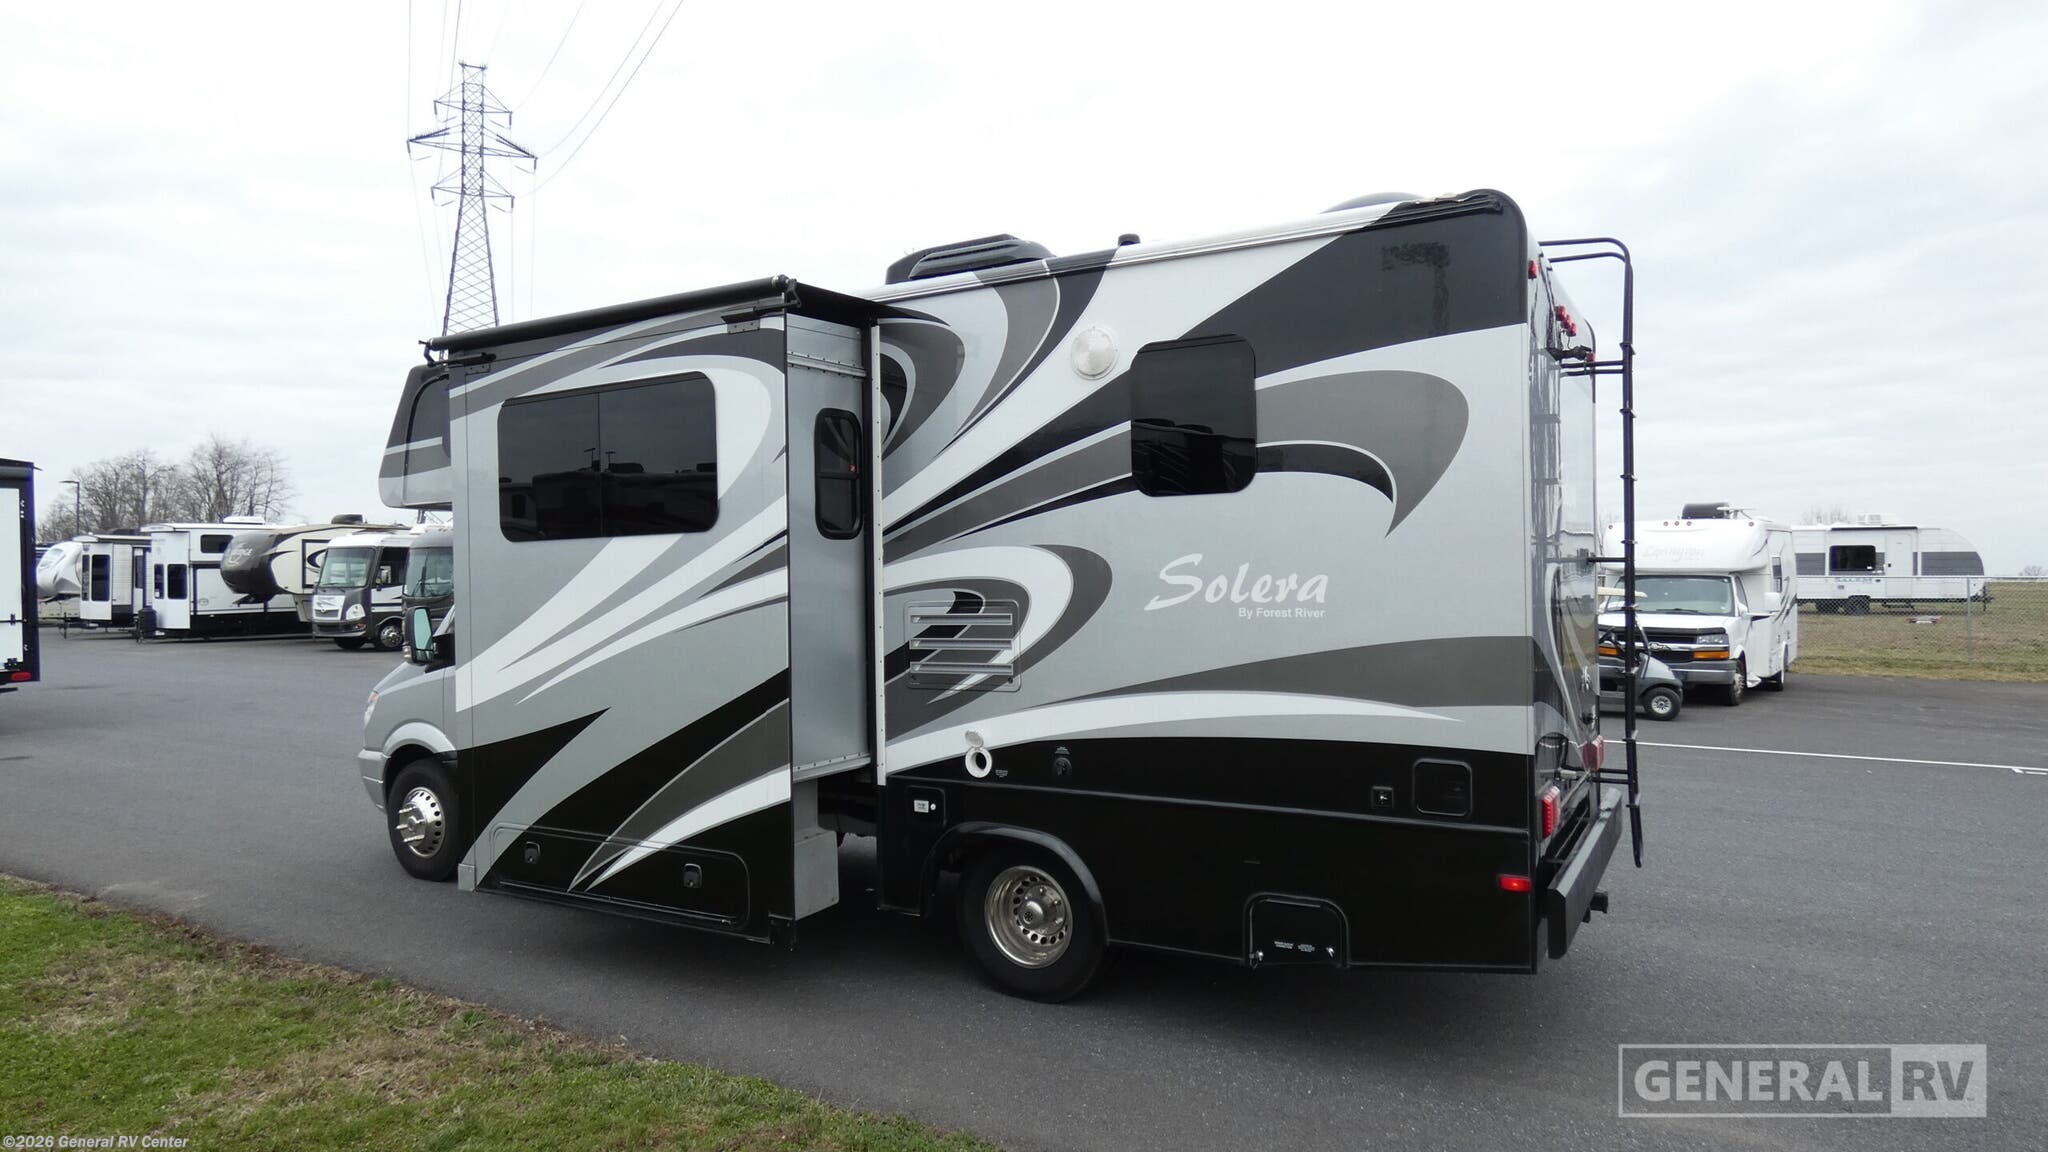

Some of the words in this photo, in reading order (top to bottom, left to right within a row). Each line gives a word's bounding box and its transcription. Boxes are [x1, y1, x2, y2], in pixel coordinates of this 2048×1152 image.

[1144, 553, 1329, 611] Solera
[1238, 607, 1253, 619] By
[1256, 608, 1292, 618] Forest
[1295, 608, 1325, 618] River
